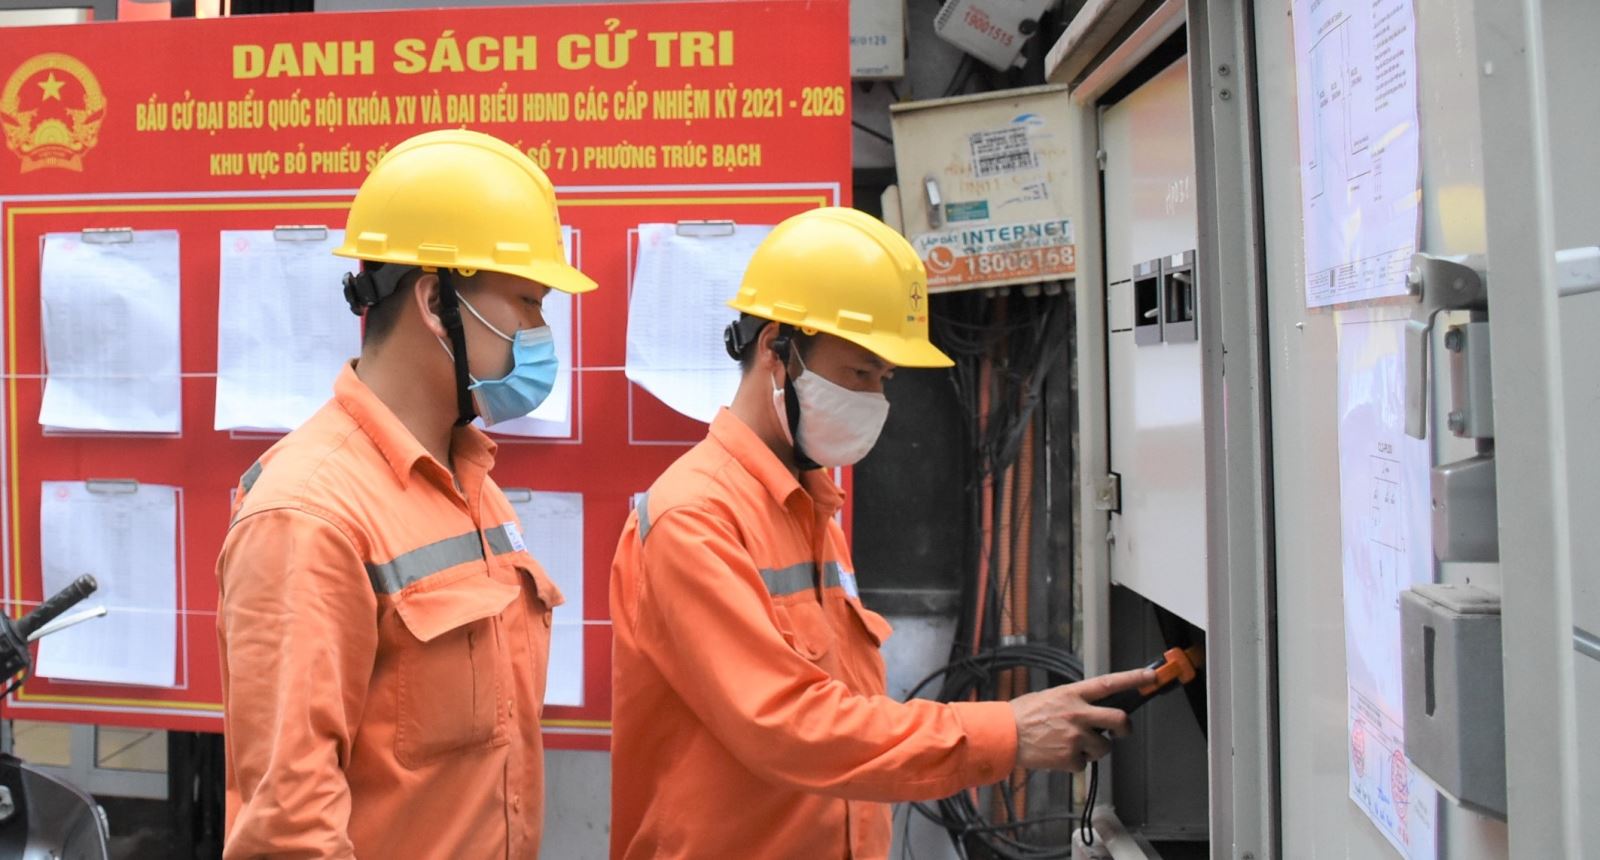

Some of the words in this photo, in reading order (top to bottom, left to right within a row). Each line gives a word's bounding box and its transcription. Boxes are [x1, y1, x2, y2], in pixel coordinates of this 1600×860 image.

[232, 40, 374, 79] DANH
[393, 30, 537, 74] SÁCH
[557, 18, 638, 70] CỬ
[648, 30, 734, 68] TRI
[964, 10, 1014, 47] 19001515
[172, 89, 196, 131] CỬ
[197, 101, 223, 136] ĐẠI
[227, 88, 263, 129] BIỂU
[267, 88, 311, 132] QUỐC
[315, 91, 342, 133] HỘI
[347, 90, 391, 126] KHÓA
[395, 95, 417, 125] XV
[420, 88, 443, 124] VÀ
[447, 94, 475, 130] ĐẠI
[479, 81, 518, 123] BIỂU
[522, 92, 570, 122] HĐND
[574, 85, 609, 122] CÁC
[613, 80, 648, 120] CẤP
[653, 83, 710, 126] NHIỆM
[715, 82, 737, 119] KỲ
[741, 88, 783, 118] 2021
[789, 100, 797, 108] -
[801, 86, 845, 117] 2026
[210, 153, 243, 176] KHU
[247, 150, 280, 180] VỰC
[284, 142, 307, 174] BỎ
[311, 142, 361, 174] PHIẾU
[527, 139, 551, 170] SỐ
[555, 147, 567, 170] 7
[571, 147, 578, 172] )
[584, 139, 657, 169] PHƯỜNG
[661, 140, 707, 168] TRÚC
[712, 143, 761, 172] BẠCH
[962, 219, 1070, 245] INTERNET
